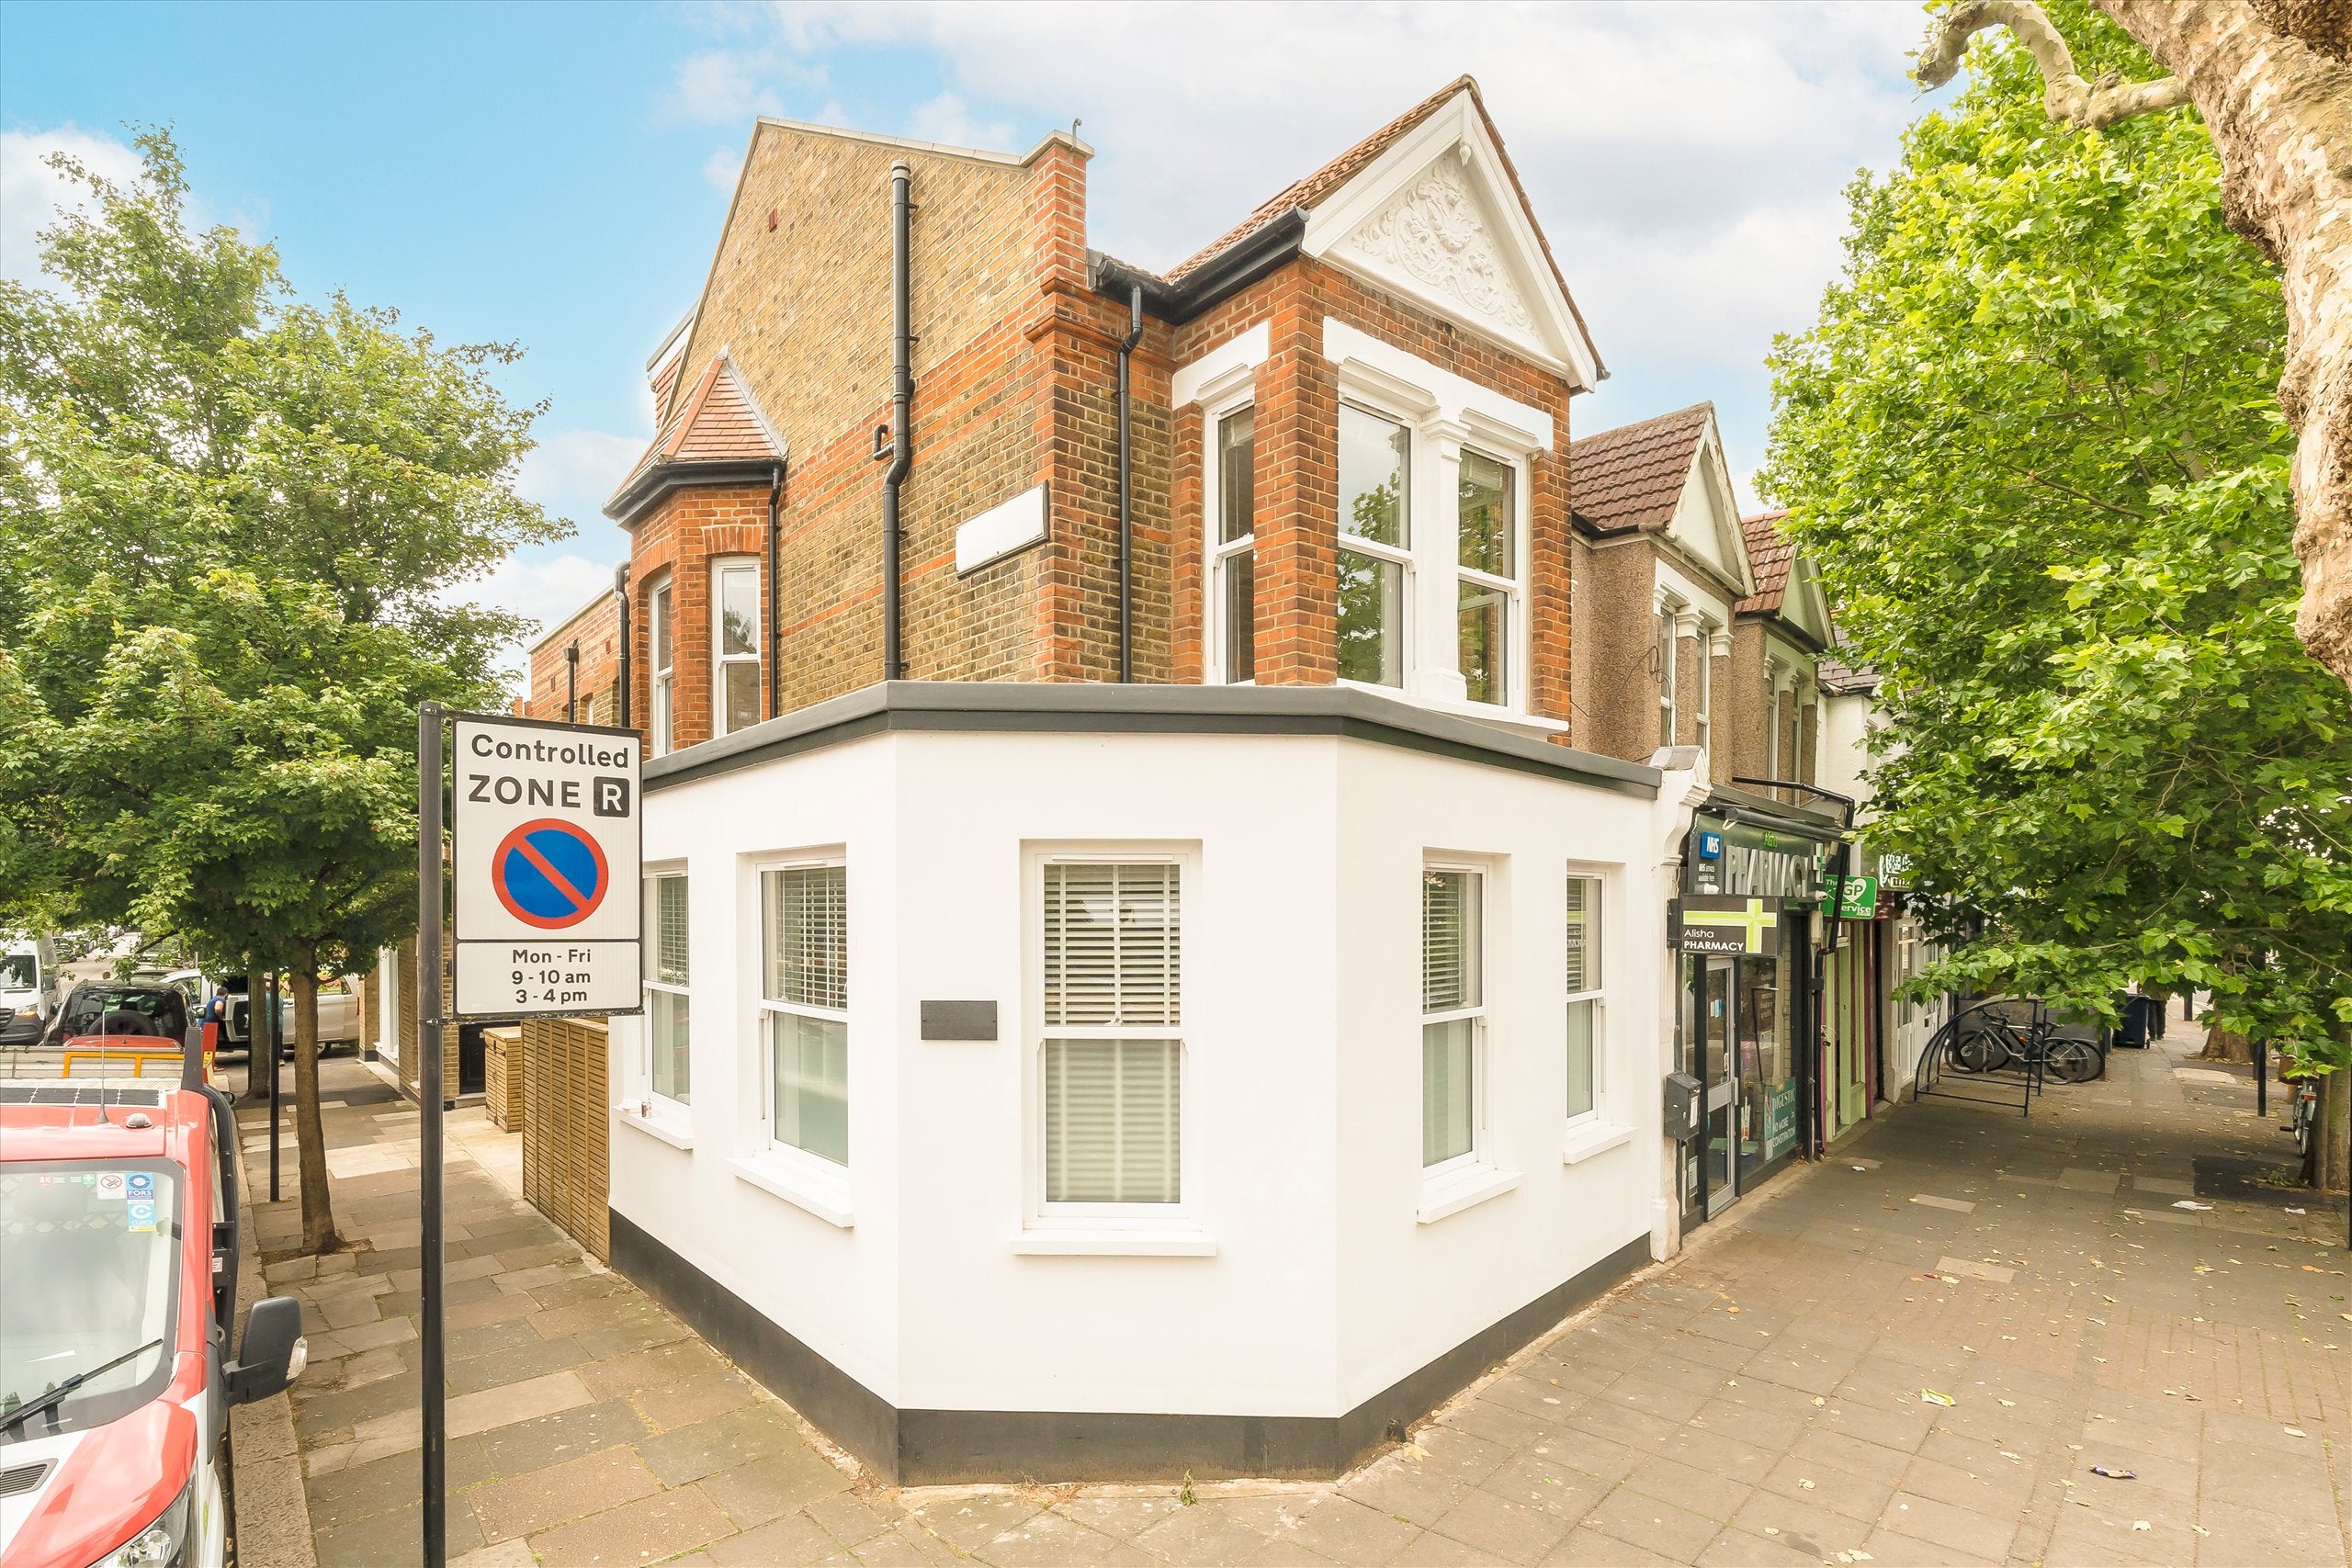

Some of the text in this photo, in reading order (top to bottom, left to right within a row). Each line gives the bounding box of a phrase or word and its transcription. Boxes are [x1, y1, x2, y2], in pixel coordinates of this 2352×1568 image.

[471, 734, 628, 768] Controlled
[469, 773, 623, 811] ZONE R
[1706, 836, 1720, 854] NHS
[1725, 844, 1810, 898] PHARMACY
[1844, 885, 1863, 896] GP
[1841, 904, 1871, 913] ervice
[1684, 929, 1714, 938] Alisha
[1684, 941, 1744, 951] PHARMACY
[513, 949, 552, 964] Mon
[568, 949, 591, 963] Fri
[512, 970, 524, 985] 9
[538, 969, 560, 984] 10
[564, 972, 591, 984] am
[515, 988, 527, 1004] 3
[542, 988, 556, 1002] 4
[560, 990, 588, 1005] pm
